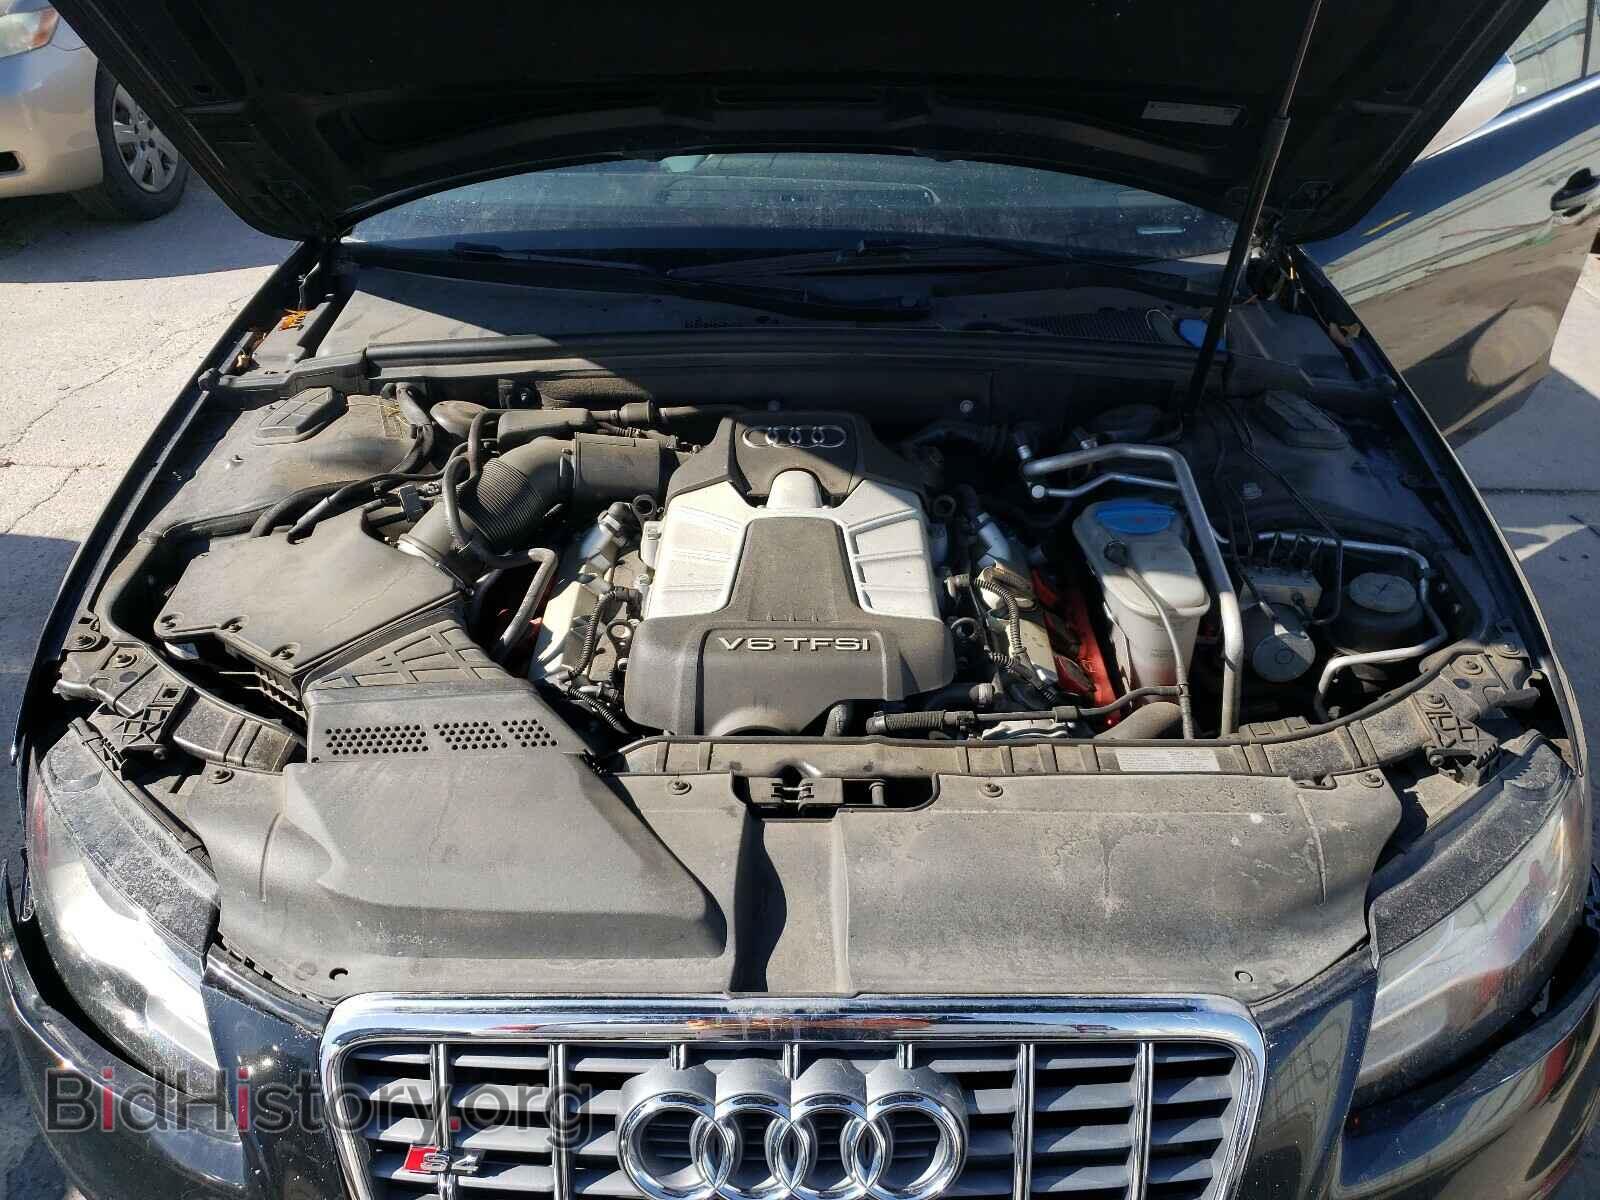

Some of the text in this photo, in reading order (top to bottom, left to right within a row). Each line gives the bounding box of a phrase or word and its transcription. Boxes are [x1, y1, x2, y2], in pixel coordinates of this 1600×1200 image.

[718, 636, 871, 652] V6 TFSI
[419, 1151, 480, 1174] S4
